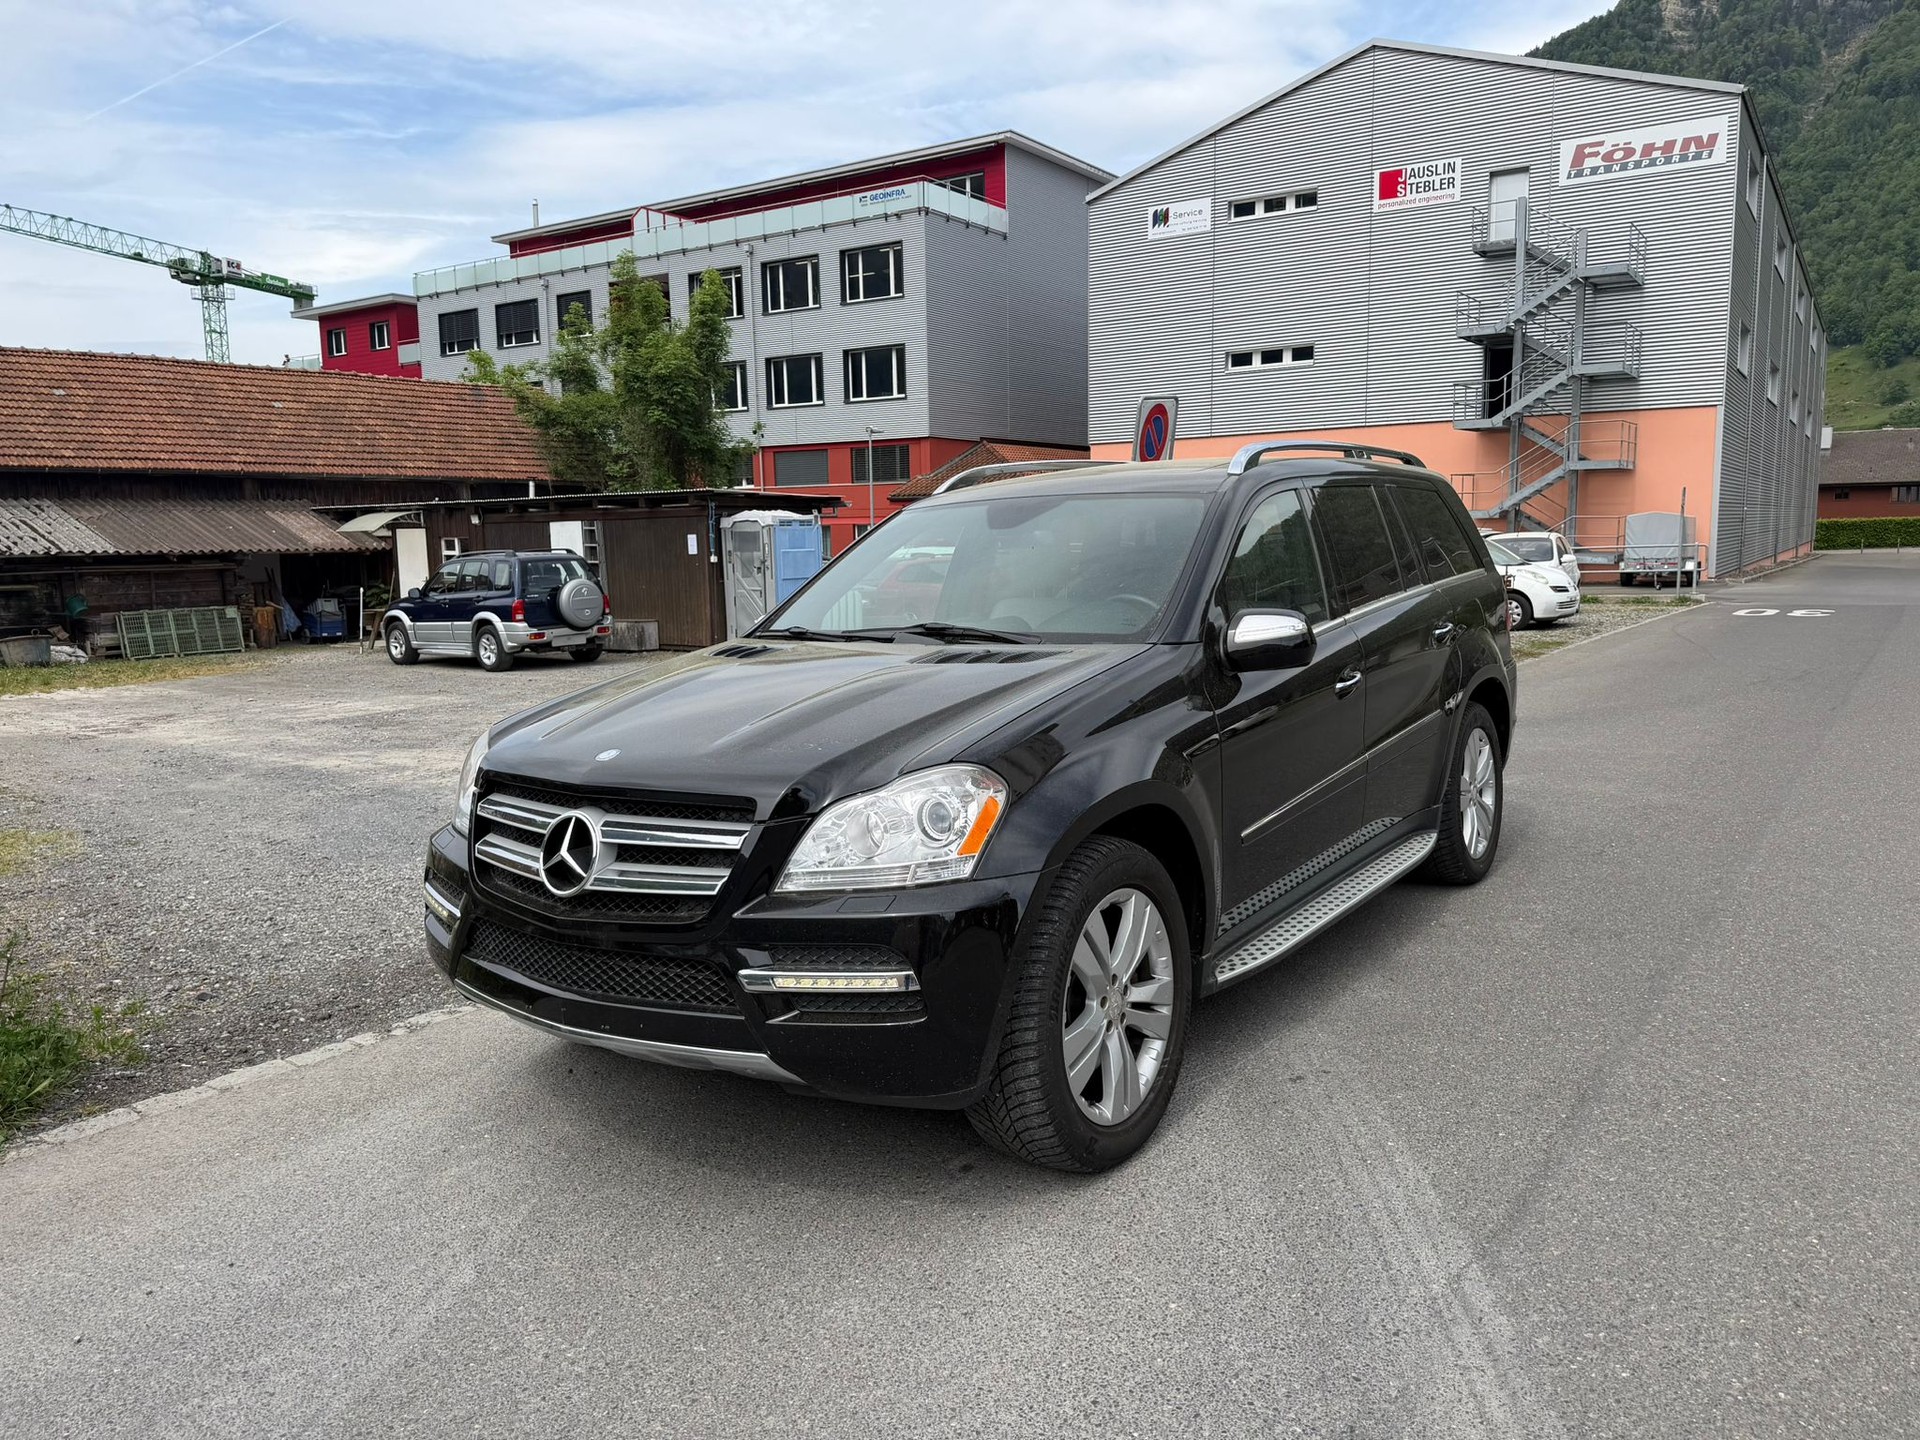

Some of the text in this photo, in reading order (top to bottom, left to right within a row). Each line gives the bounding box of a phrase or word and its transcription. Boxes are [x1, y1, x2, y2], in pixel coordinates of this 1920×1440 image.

[1569, 150, 1712, 178] TRANSPORTE
[869, 188, 906, 201] GEOINFRA
[1378, 192, 1456, 210] personalized engineering
